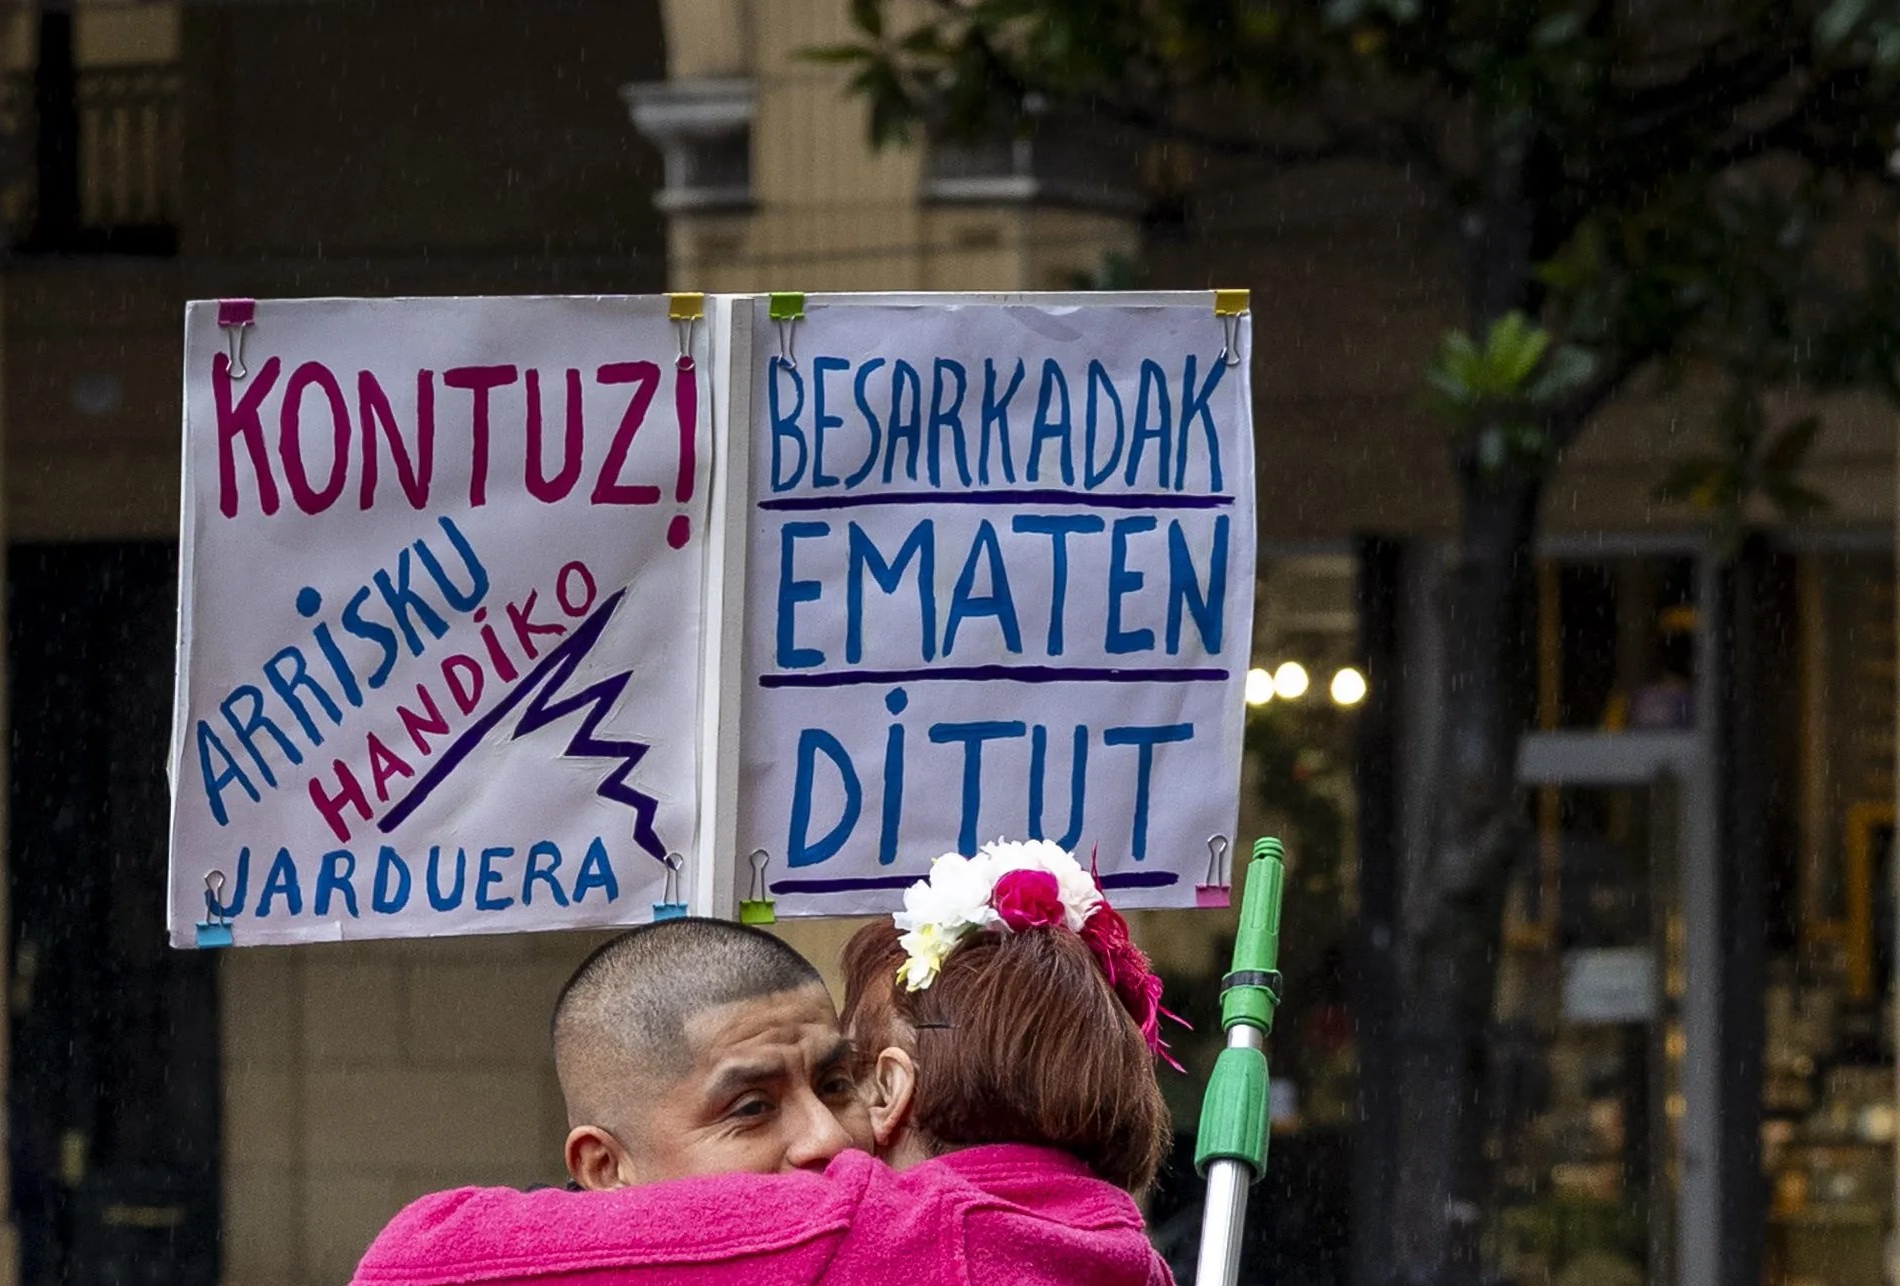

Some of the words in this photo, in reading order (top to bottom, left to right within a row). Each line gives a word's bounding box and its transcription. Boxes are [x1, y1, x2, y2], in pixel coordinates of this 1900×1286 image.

[211, 350, 700, 551] KONTUZ!
[768, 352, 1229, 494] BESARKADAK
[776, 513, 1230, 670] EMATEN
[205, 836, 619, 919] JARDUERA
